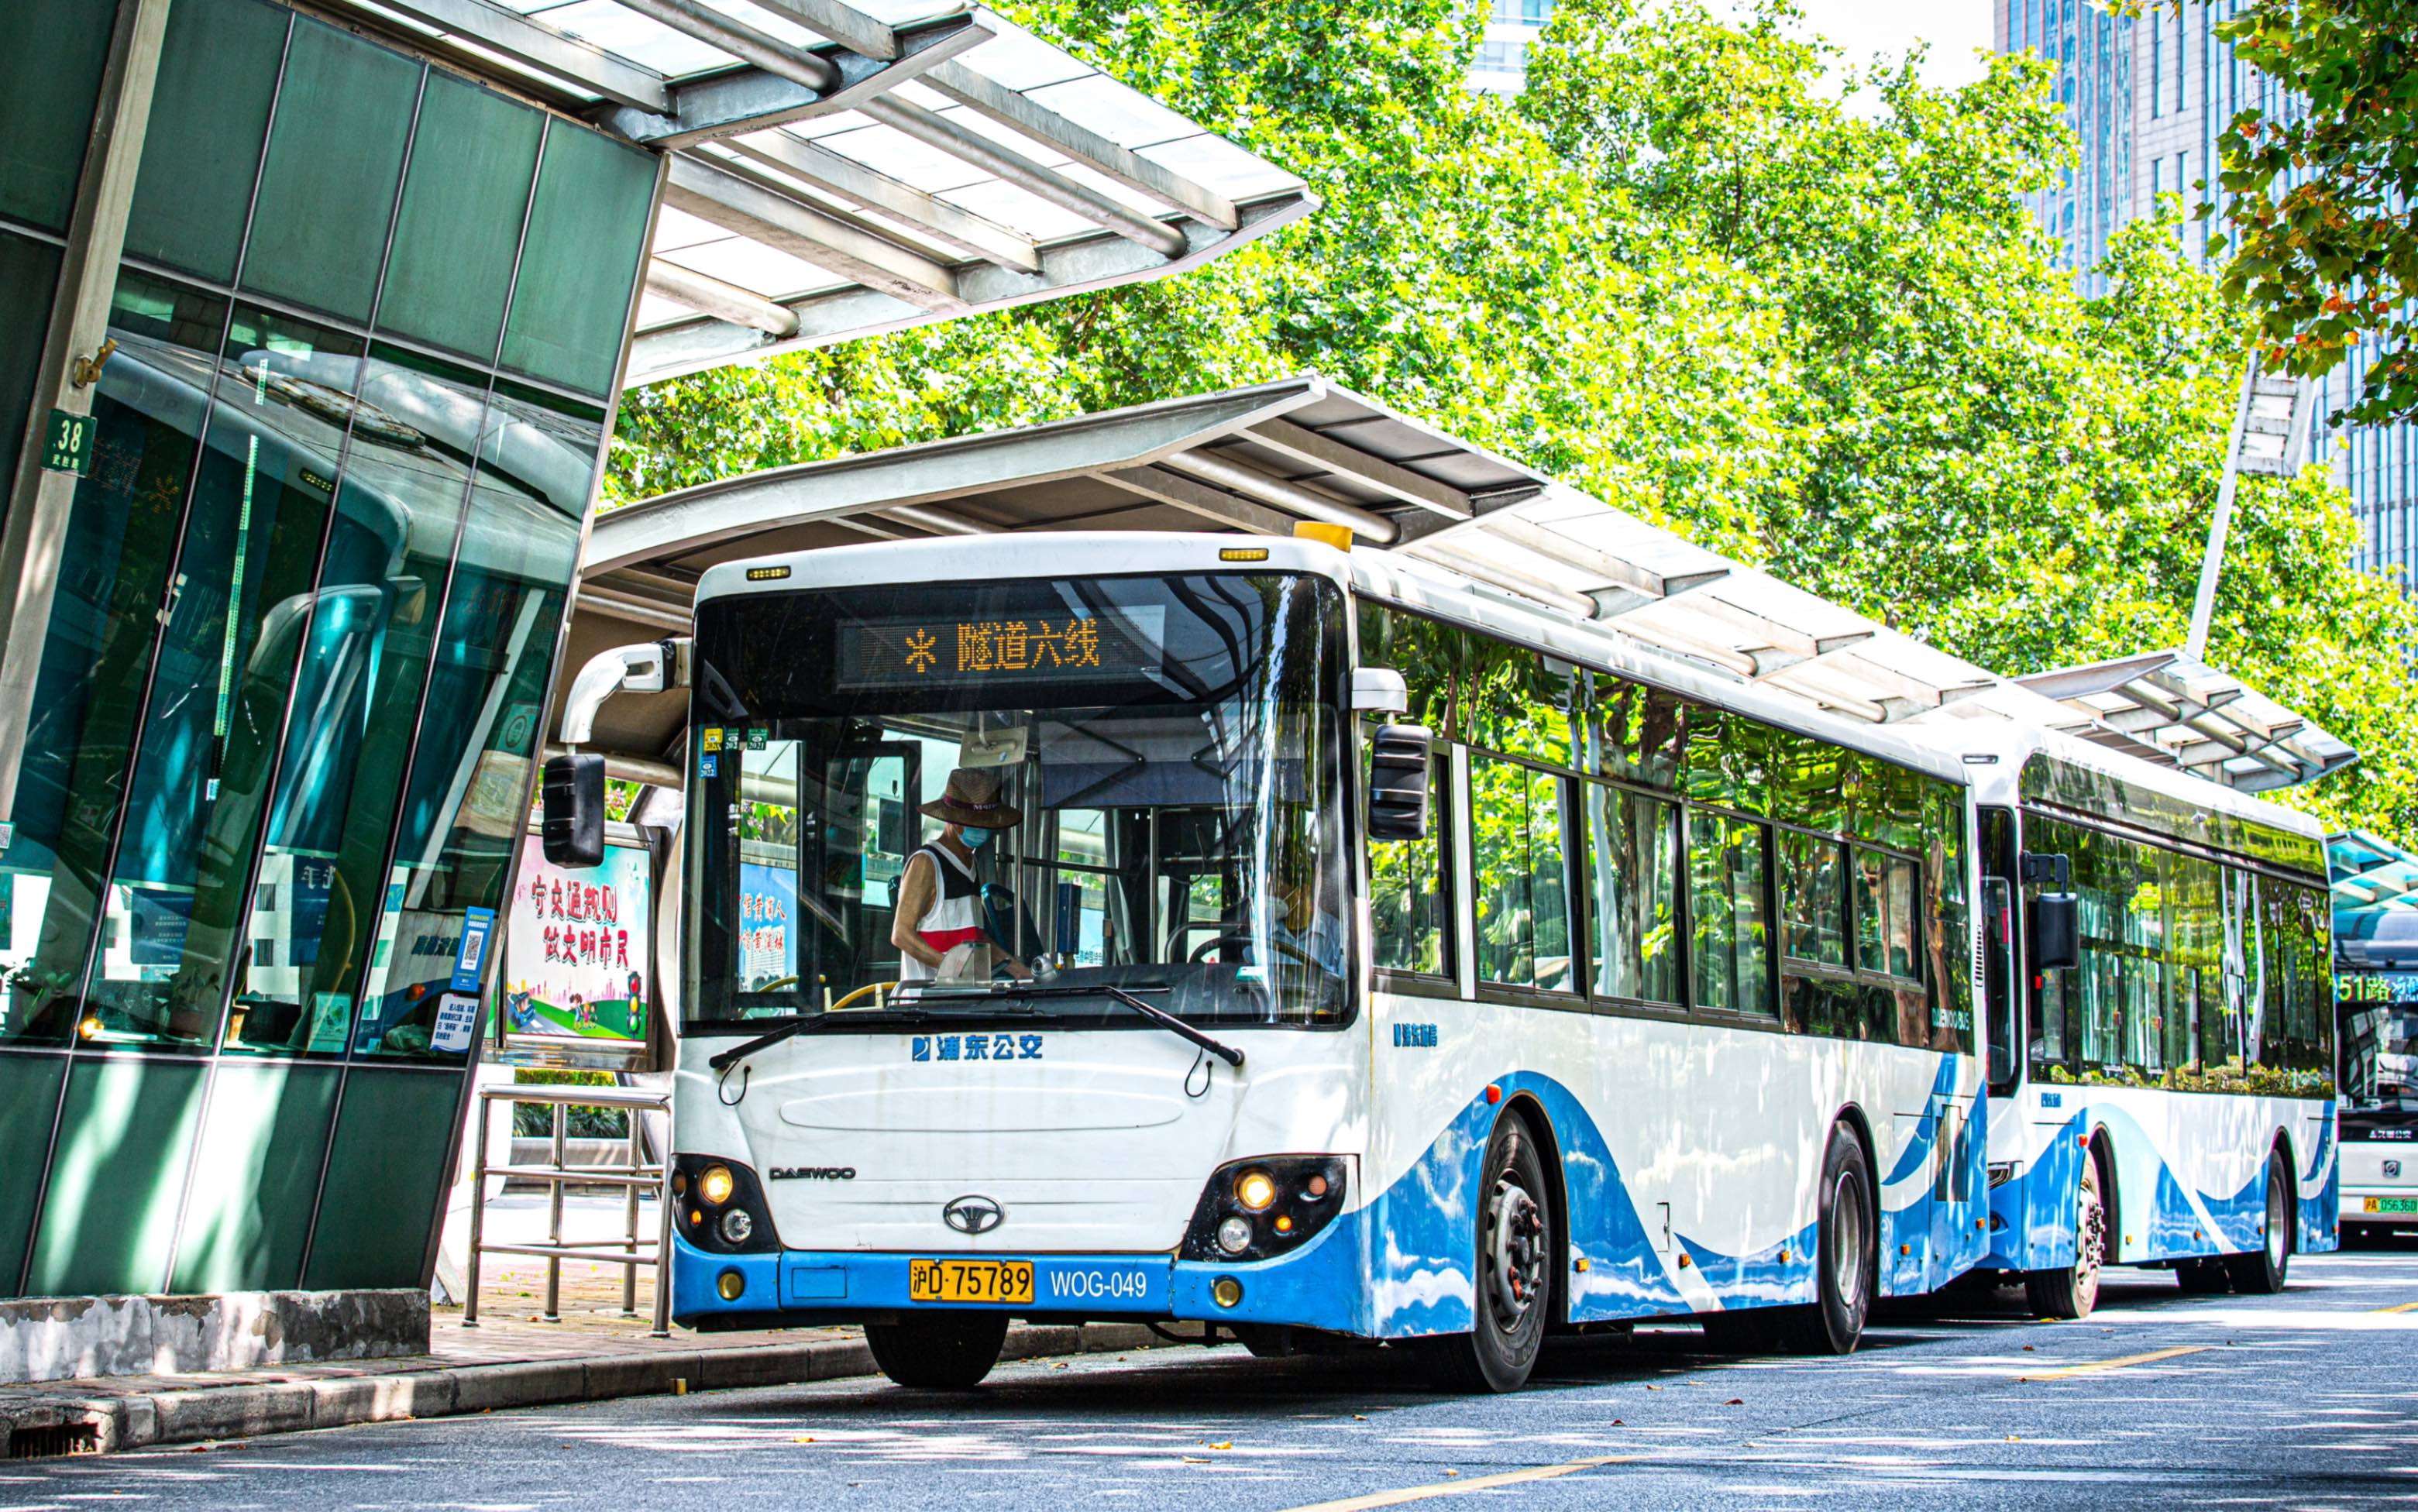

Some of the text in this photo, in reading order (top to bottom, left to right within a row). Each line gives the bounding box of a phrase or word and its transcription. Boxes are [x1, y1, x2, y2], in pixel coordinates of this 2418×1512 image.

[57, 419, 83, 452] 38
[958, 618, 1099, 671] 隧道六线
[531, 874, 617, 926] 守交通规则
[738, 892, 787, 922] 信黄浦人
[544, 924, 629, 970] 做文明市民
[937, 1035, 1043, 1060] 浦东公交
[769, 1167, 856, 1180] DAEWOO
[1050, 1270, 1147, 1298] WOG-049
